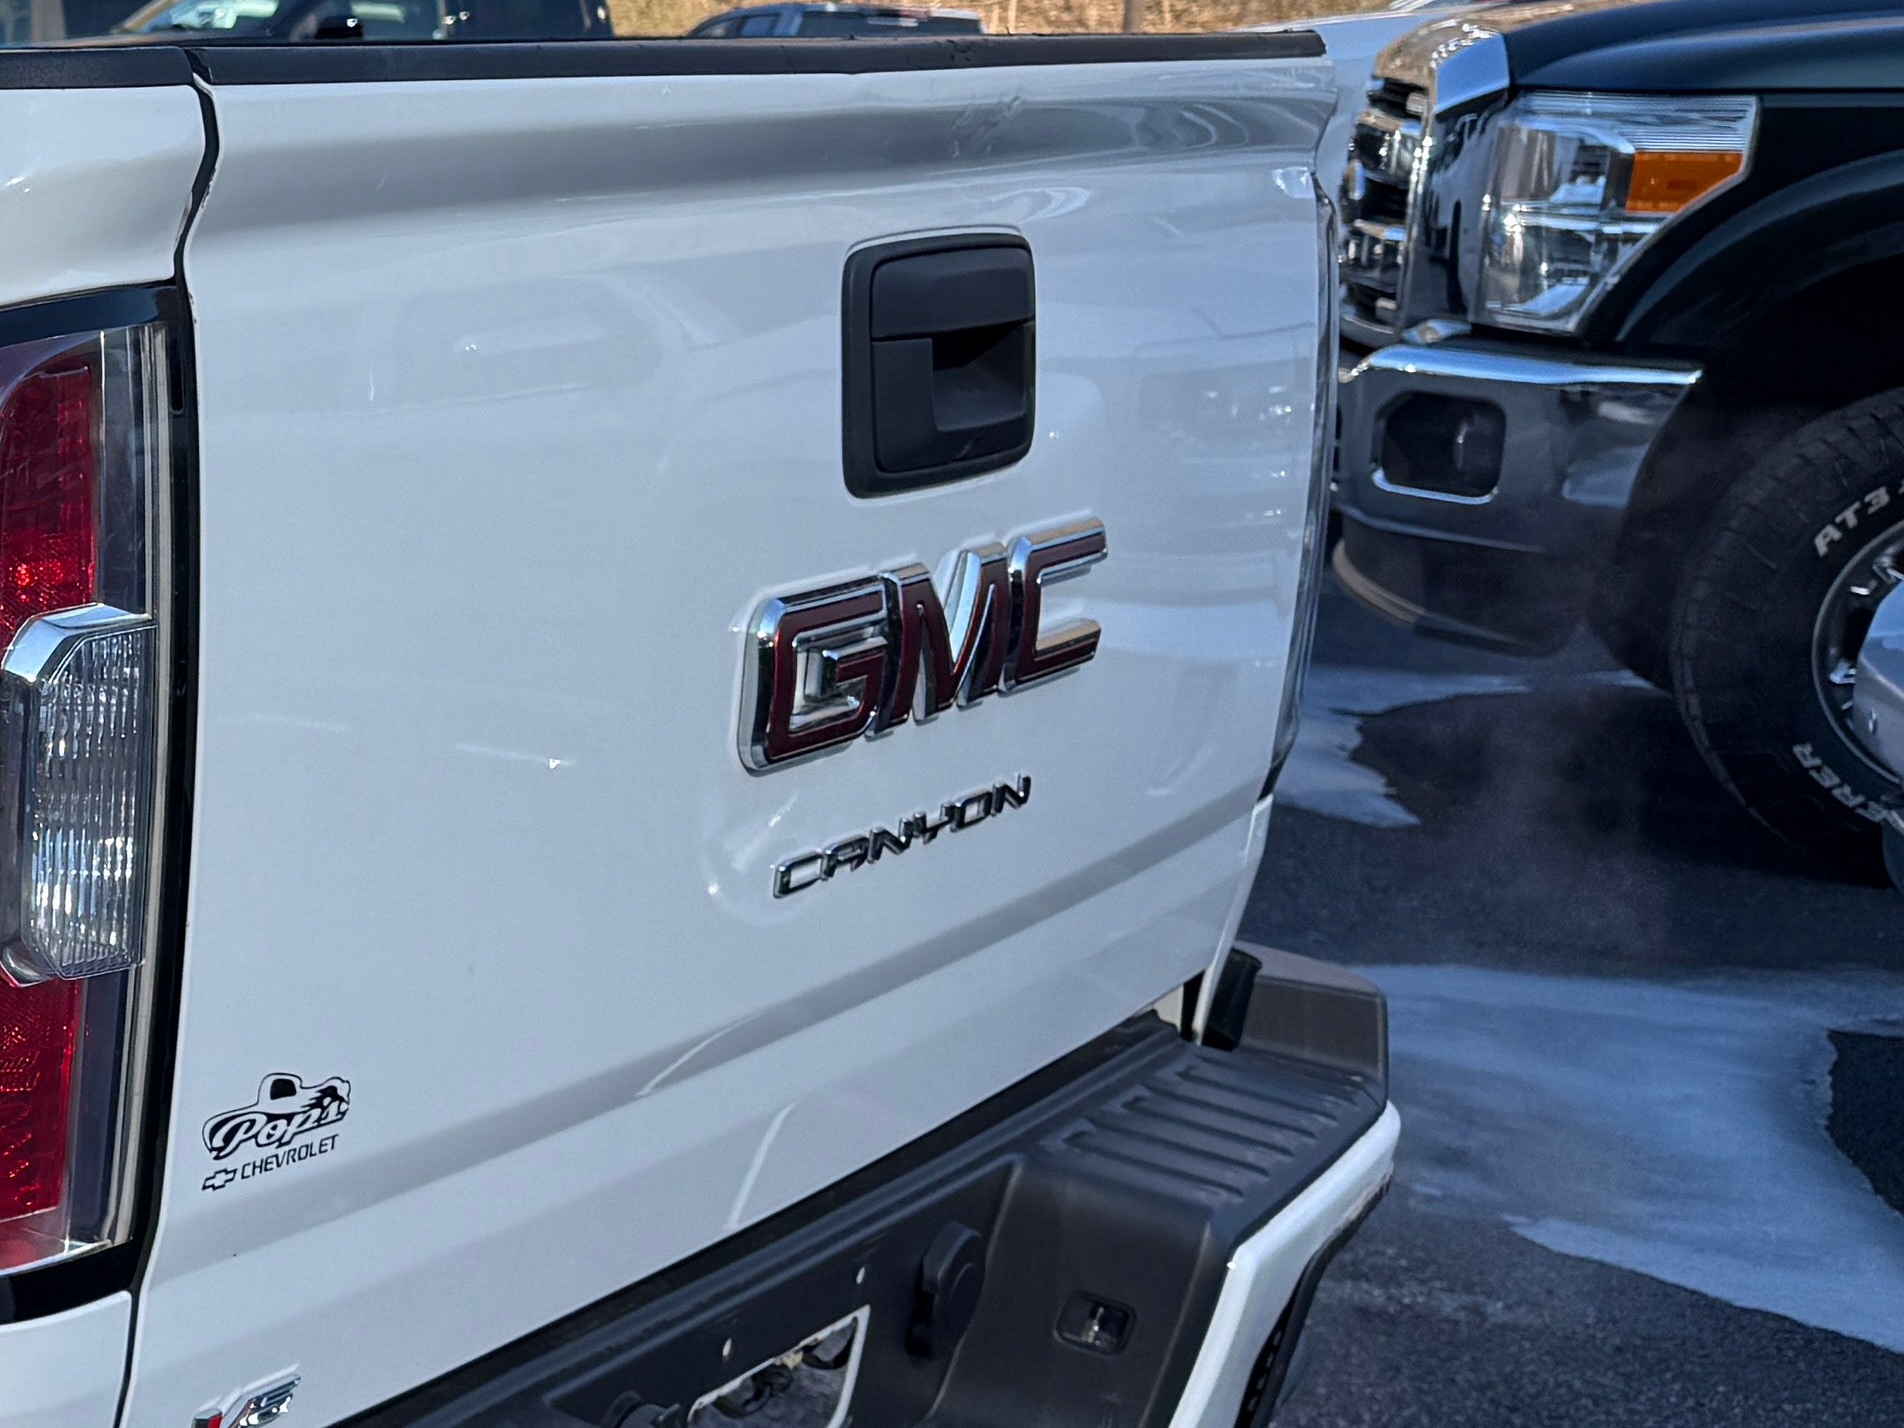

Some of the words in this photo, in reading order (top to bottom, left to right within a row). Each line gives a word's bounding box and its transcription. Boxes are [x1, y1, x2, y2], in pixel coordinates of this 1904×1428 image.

[1814, 486, 1890, 558] AT3
[736, 515, 1108, 777] GMC
[772, 773, 1031, 899] CANYON
[240, 1134, 340, 1180] CHEVROLET
